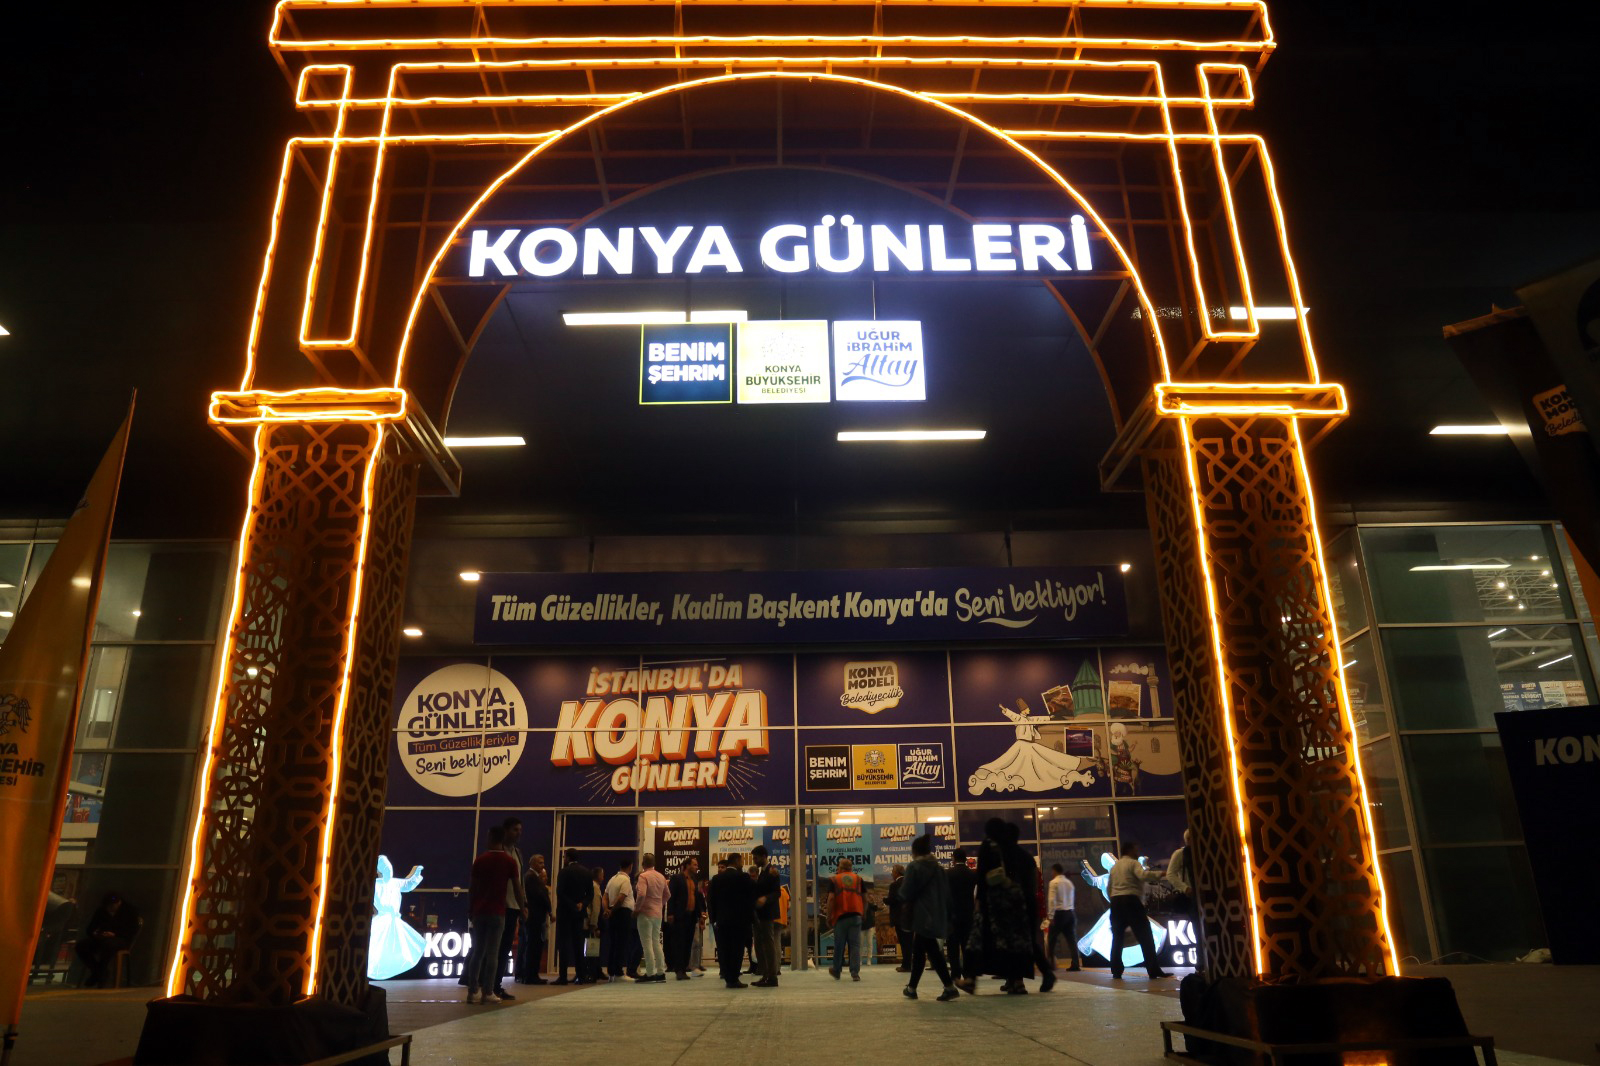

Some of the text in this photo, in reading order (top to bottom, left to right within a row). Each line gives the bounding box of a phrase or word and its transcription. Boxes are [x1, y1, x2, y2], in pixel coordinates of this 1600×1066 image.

[468, 214, 1093, 277] KONYA GÜNLERİ
[857, 327, 900, 340] UĞUR
[765, 365, 802, 373] KONYA
[842, 353, 918, 387] Altay
[491, 594, 536, 621] Tüm
[541, 592, 663, 625] Güzellikler,
[672, 592, 742, 620] Kadim
[747, 590, 839, 627] Başkent
[955, 588, 1006, 622] Seni
[1010, 572, 1105, 622] bekliyor!
[848, 665, 895, 679] KONYA
[417, 687, 506, 713] KONYA
[840, 685, 903, 707] Belediyecilik
[407, 702, 516, 739] GÜNLERİ
[550, 689, 769, 767] KONYA
[413, 733, 517, 753] Tüm Güzellikeriyle
[909, 748, 933, 756] UĞUR
[0, 757, 45, 776] EHİR
[415, 749, 511, 775] Seni bekliyor!
[903, 761, 941, 781] Altay
[610, 751, 730, 795] GÜNLERİ
[664, 829, 700, 842] KONYA
[718, 828, 754, 842] KONYA
[826, 826, 862, 840] KONYA
[880, 824, 916, 838] KONYA
